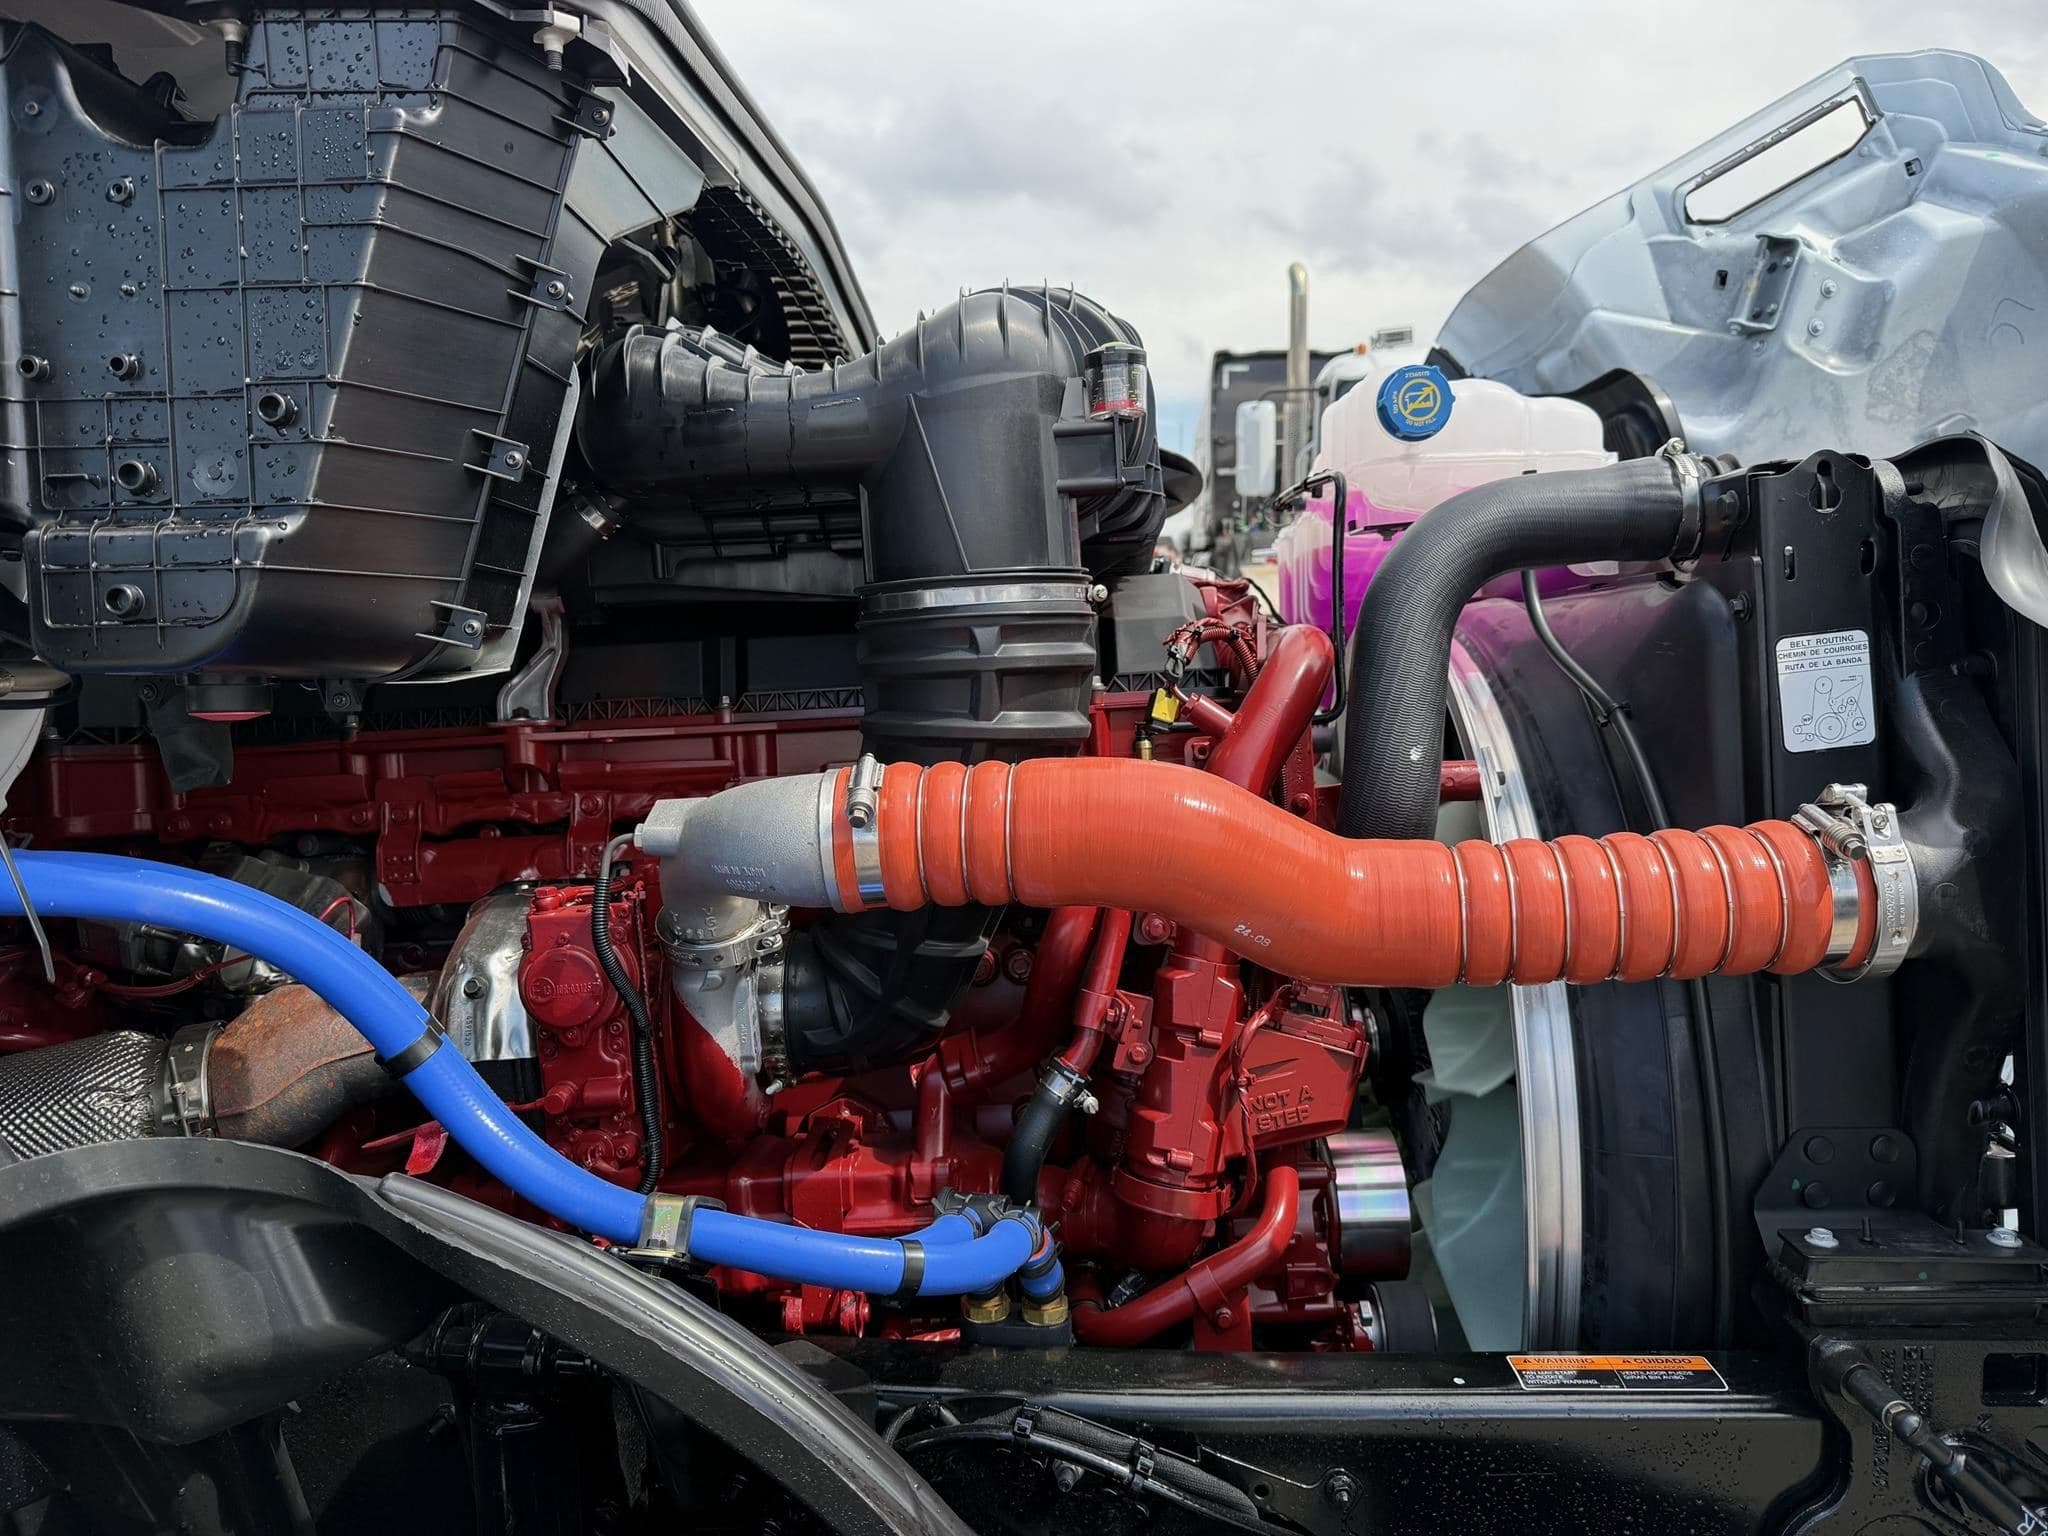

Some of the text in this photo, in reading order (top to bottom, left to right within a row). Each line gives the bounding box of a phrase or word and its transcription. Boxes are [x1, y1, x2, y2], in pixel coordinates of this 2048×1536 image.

[1789, 634, 1854, 649] BELT ROUTING
[1777, 643, 1868, 660] CHEMIN DE COURROIES
[1784, 663, 1805, 671] RUTA
[1836, 657, 1862, 665] BANDA
[1250, 1084, 1314, 1113] NOT A
[1256, 1104, 1310, 1131] STEP
